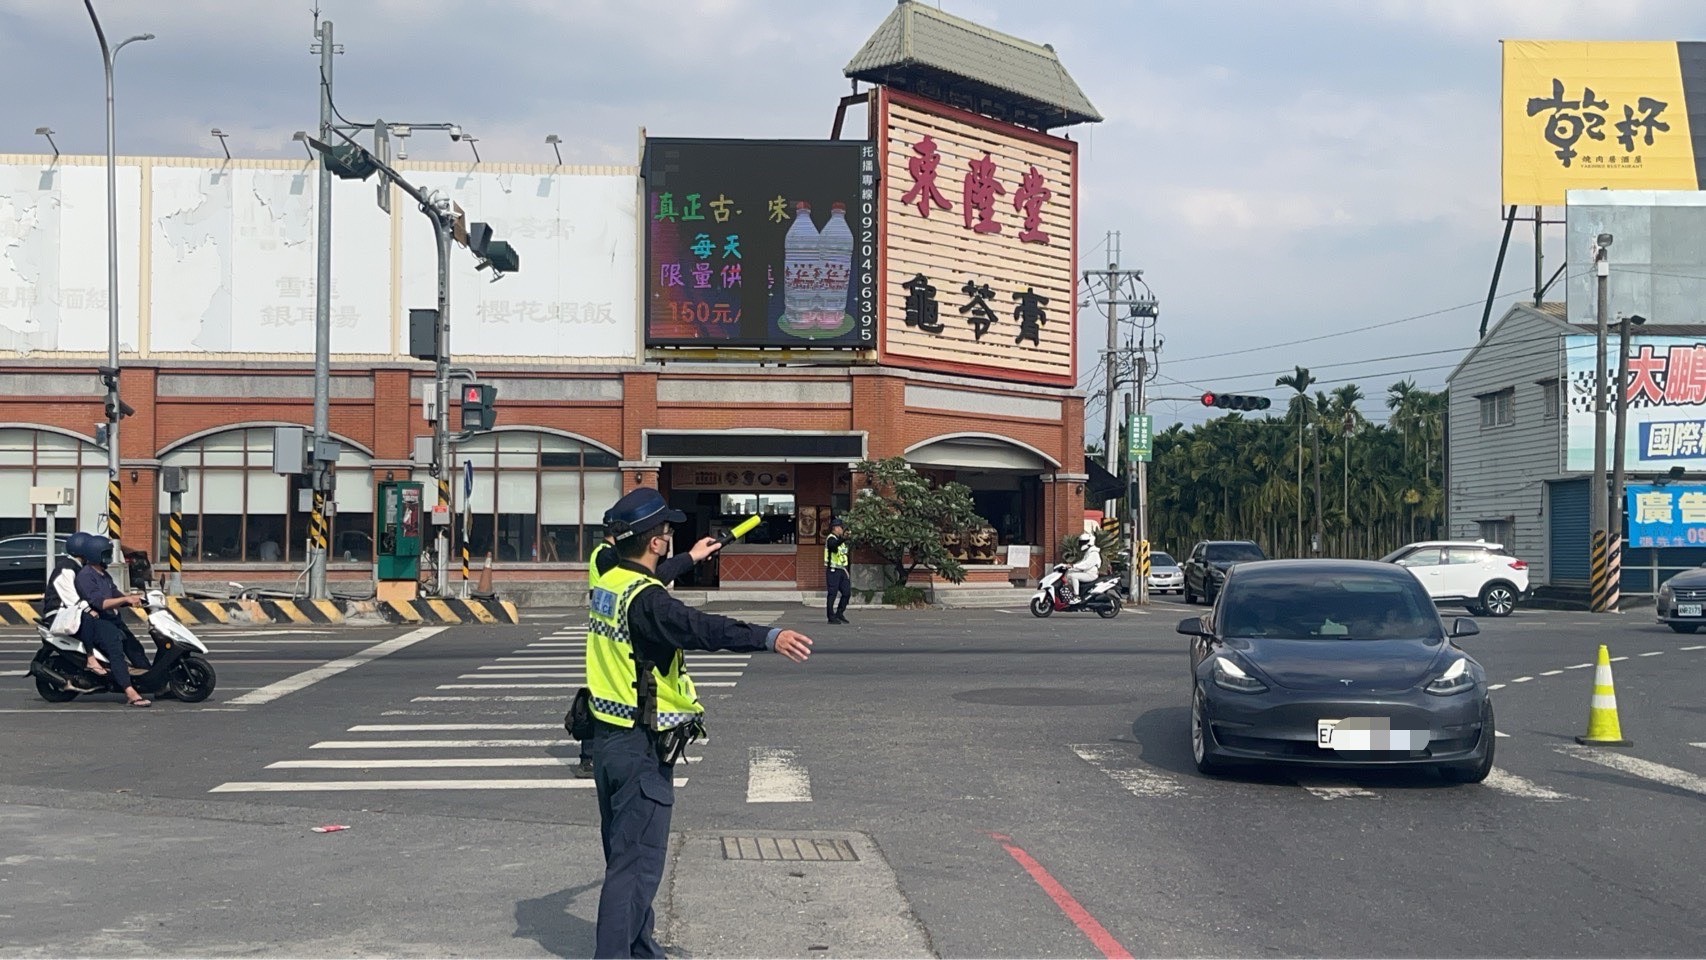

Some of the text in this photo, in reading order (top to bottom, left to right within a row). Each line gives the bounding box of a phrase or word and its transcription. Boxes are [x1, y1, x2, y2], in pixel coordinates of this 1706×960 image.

[1527, 78, 1670, 168] 乾杯
[901, 134, 1052, 244] 東隆堂
[690, 233, 742, 260] 每天
[476, 300, 616, 324] 櫻花蝦飯
[902, 273, 1050, 347] 龜苓膏
